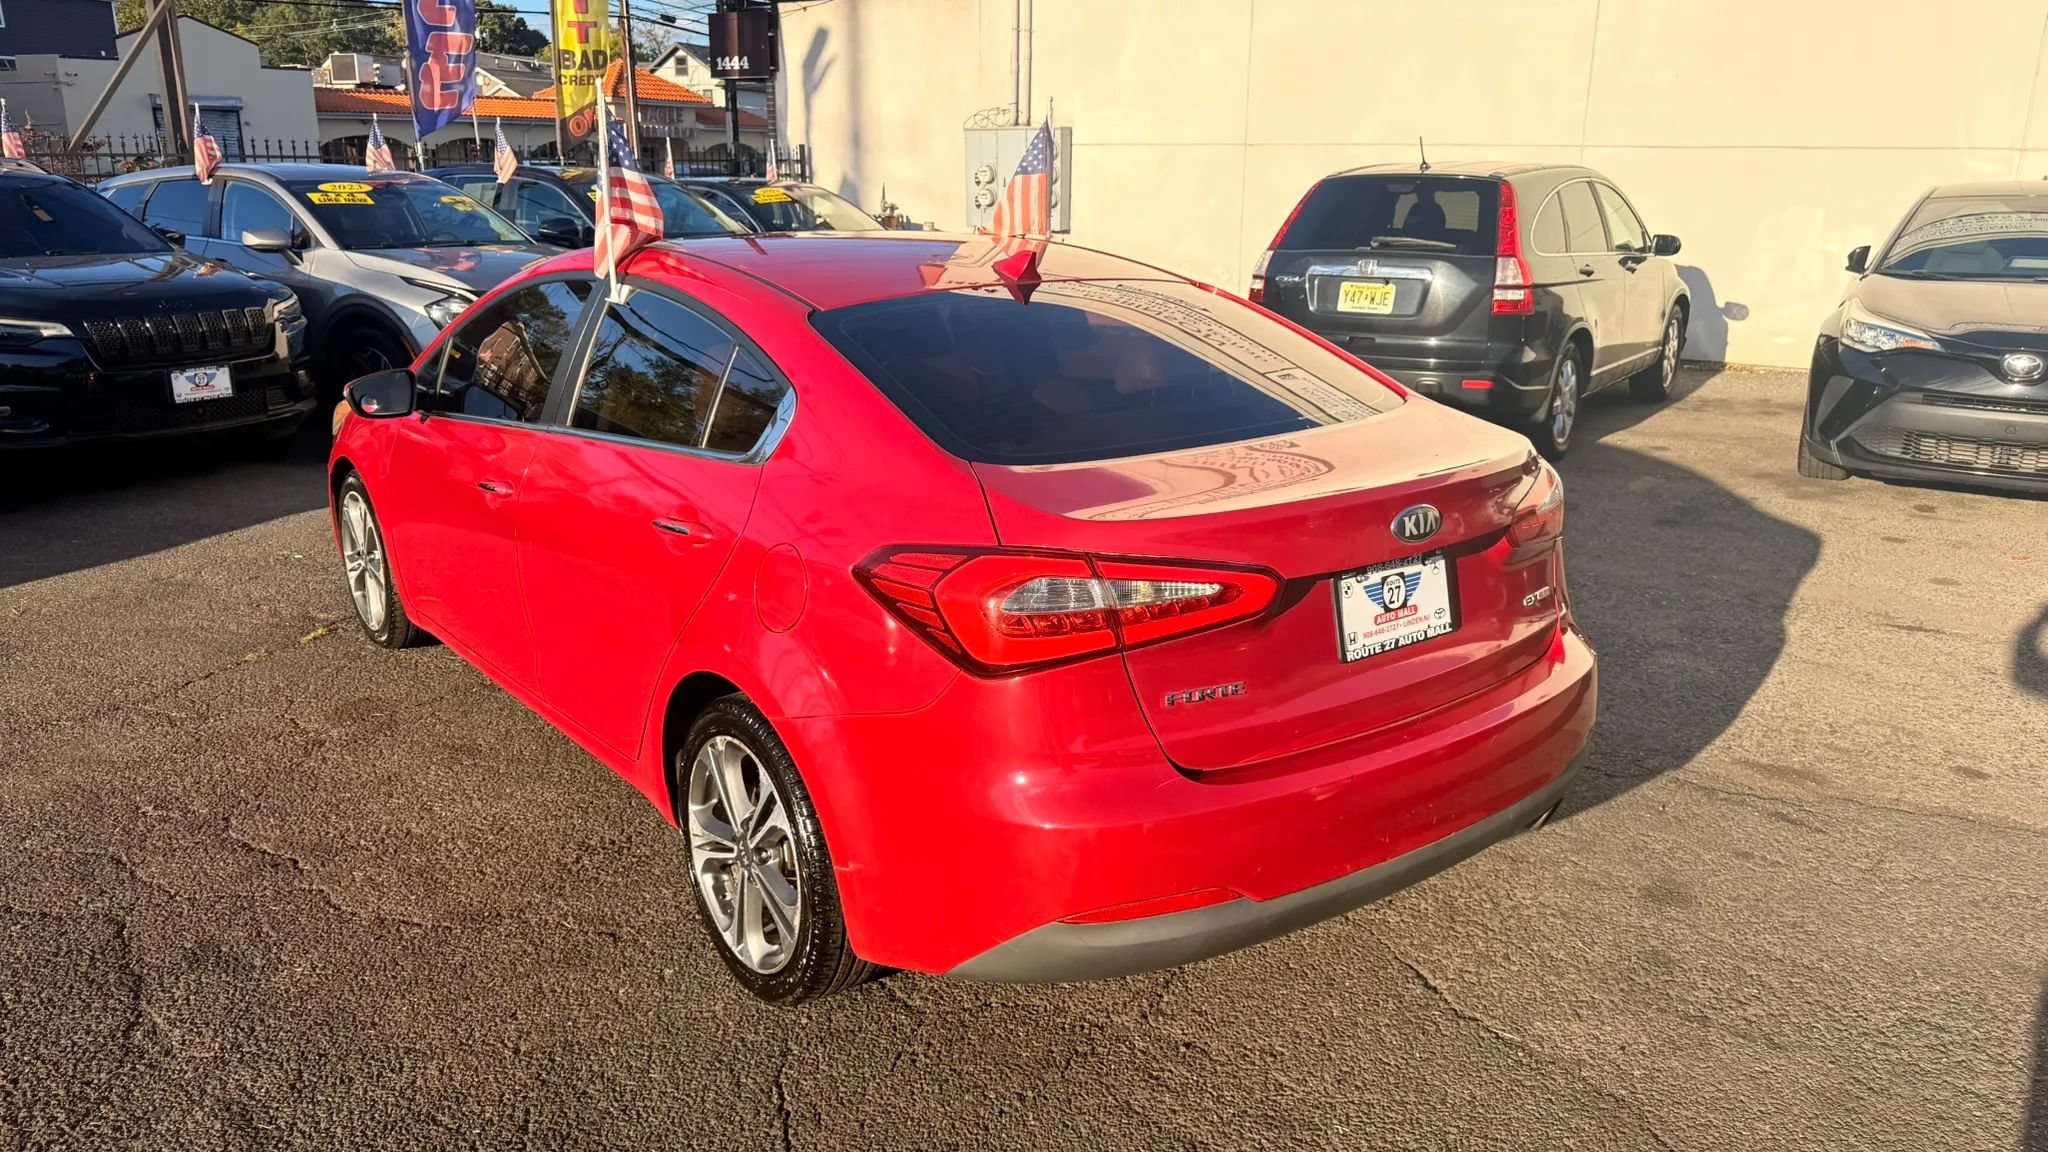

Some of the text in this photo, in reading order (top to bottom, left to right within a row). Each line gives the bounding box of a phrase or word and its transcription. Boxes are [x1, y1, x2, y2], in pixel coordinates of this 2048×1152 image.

[559, 49, 608, 71] BAD
[716, 55, 750, 70] 1444
[558, 73, 604, 86] CRED
[1403, 511, 1436, 537] KIA
[1387, 585, 1402, 605] 27
[1375, 604, 1417, 625] AUTO MALL
[1346, 622, 1453, 662] ROUTE 27 AUTO MALL
[1164, 682, 1247, 707] FORTE
